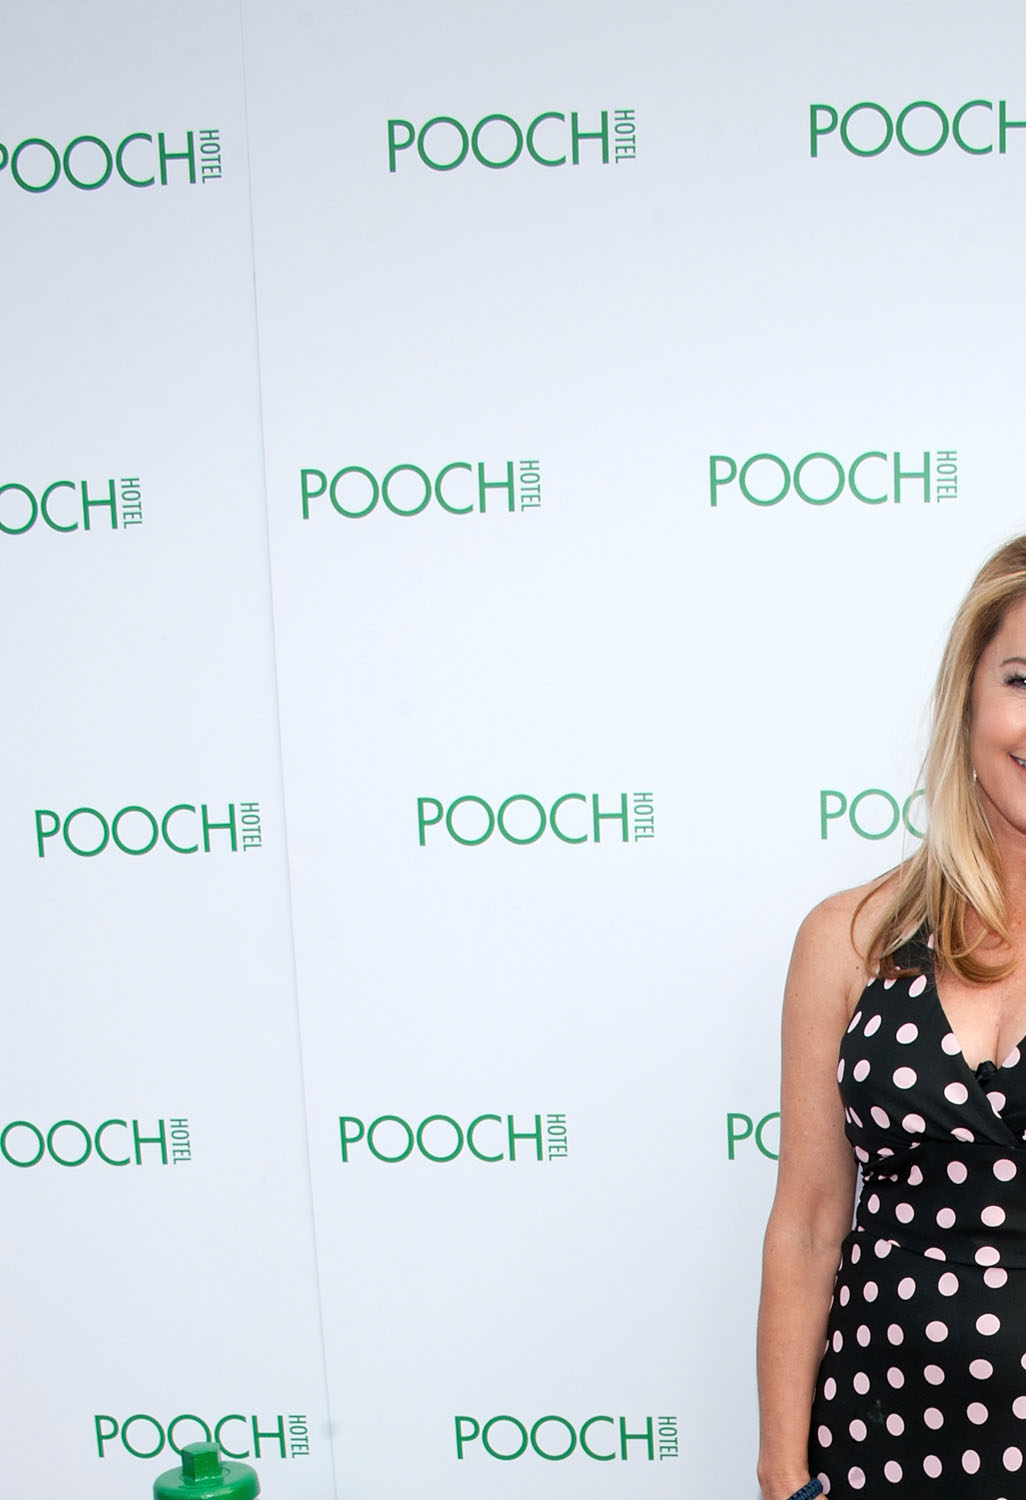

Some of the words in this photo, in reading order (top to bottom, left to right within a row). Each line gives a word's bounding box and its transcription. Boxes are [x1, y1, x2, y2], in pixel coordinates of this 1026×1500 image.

[200, 130, 221, 183] HOTEL
[388, 111, 609, 172] POOCH
[614, 110, 635, 163] HOTEL
[121, 478, 142, 528] HOTEL
[301, 461, 514, 519] POOCH
[520, 460, 540, 512] HOTEL
[710, 451, 930, 506] POOCH
[937, 451, 957, 503] HOTEL
[35, 804, 237, 857] POOCH
[240, 803, 261, 851] HOTEL
[417, 793, 628, 846] POOCH
[634, 792, 654, 842] HOTEL
[0, 1119, 167, 1167] OOCH
[170, 1119, 191, 1164] HOTEL
[339, 1114, 542, 1162] POOCH
[547, 1114, 567, 1160] HOTEL
[94, 1413, 286, 1460] POOCH
[288, 1415, 309, 1458] HOTEL
[455, 1415, 654, 1461] POOCH
[658, 1417, 678, 1460] HOTEL
